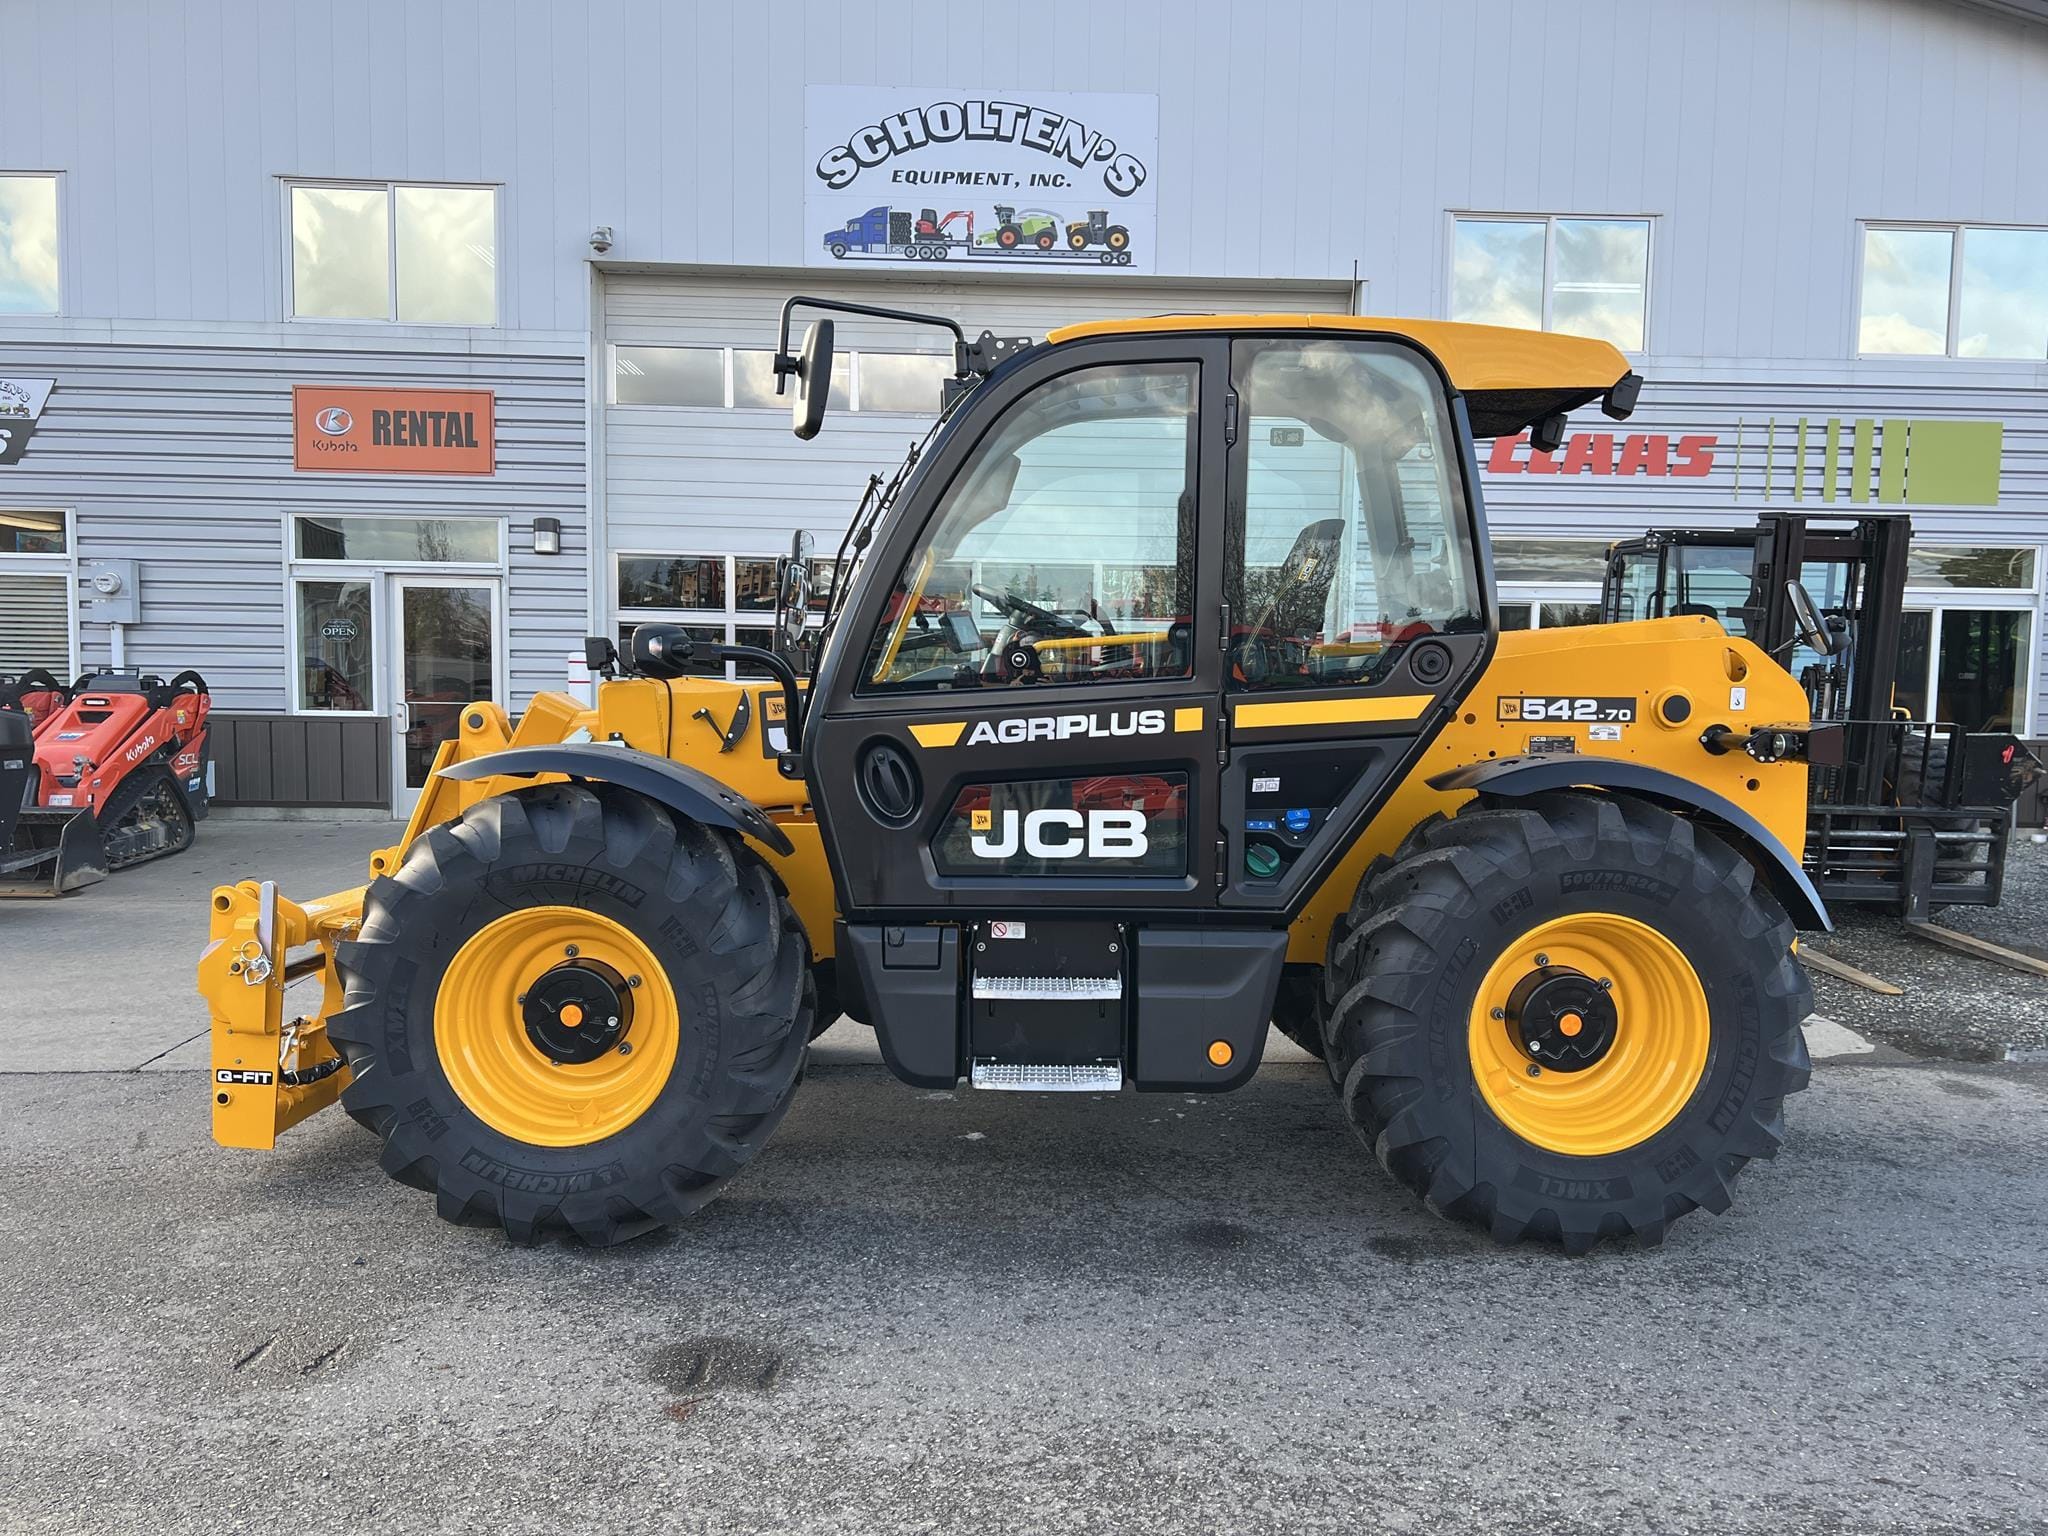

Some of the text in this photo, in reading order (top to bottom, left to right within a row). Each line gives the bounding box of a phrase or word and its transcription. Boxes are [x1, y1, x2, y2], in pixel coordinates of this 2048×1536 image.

[815, 101, 1147, 198] SCHOLTEN'S
[891, 169, 1072, 188] EQUIPMENT, INC.
[312, 439, 358, 452] Kubota
[372, 409, 479, 448] RENTAL
[1487, 432, 1719, 477] CLAAS
[322, 627, 355, 636] OPEN
[966, 709, 1166, 746] AGRIPLUS
[1522, 698, 1632, 721] 542-70
[125, 735, 155, 762] Kubota
[178, 753, 198, 766] SCL
[971, 809, 1148, 858] JCB
[511, 864, 646, 904] MICHELIN
[1714, 1006, 1758, 1134] MICHELIN
[461, 1153, 593, 1194] MICHELIN
